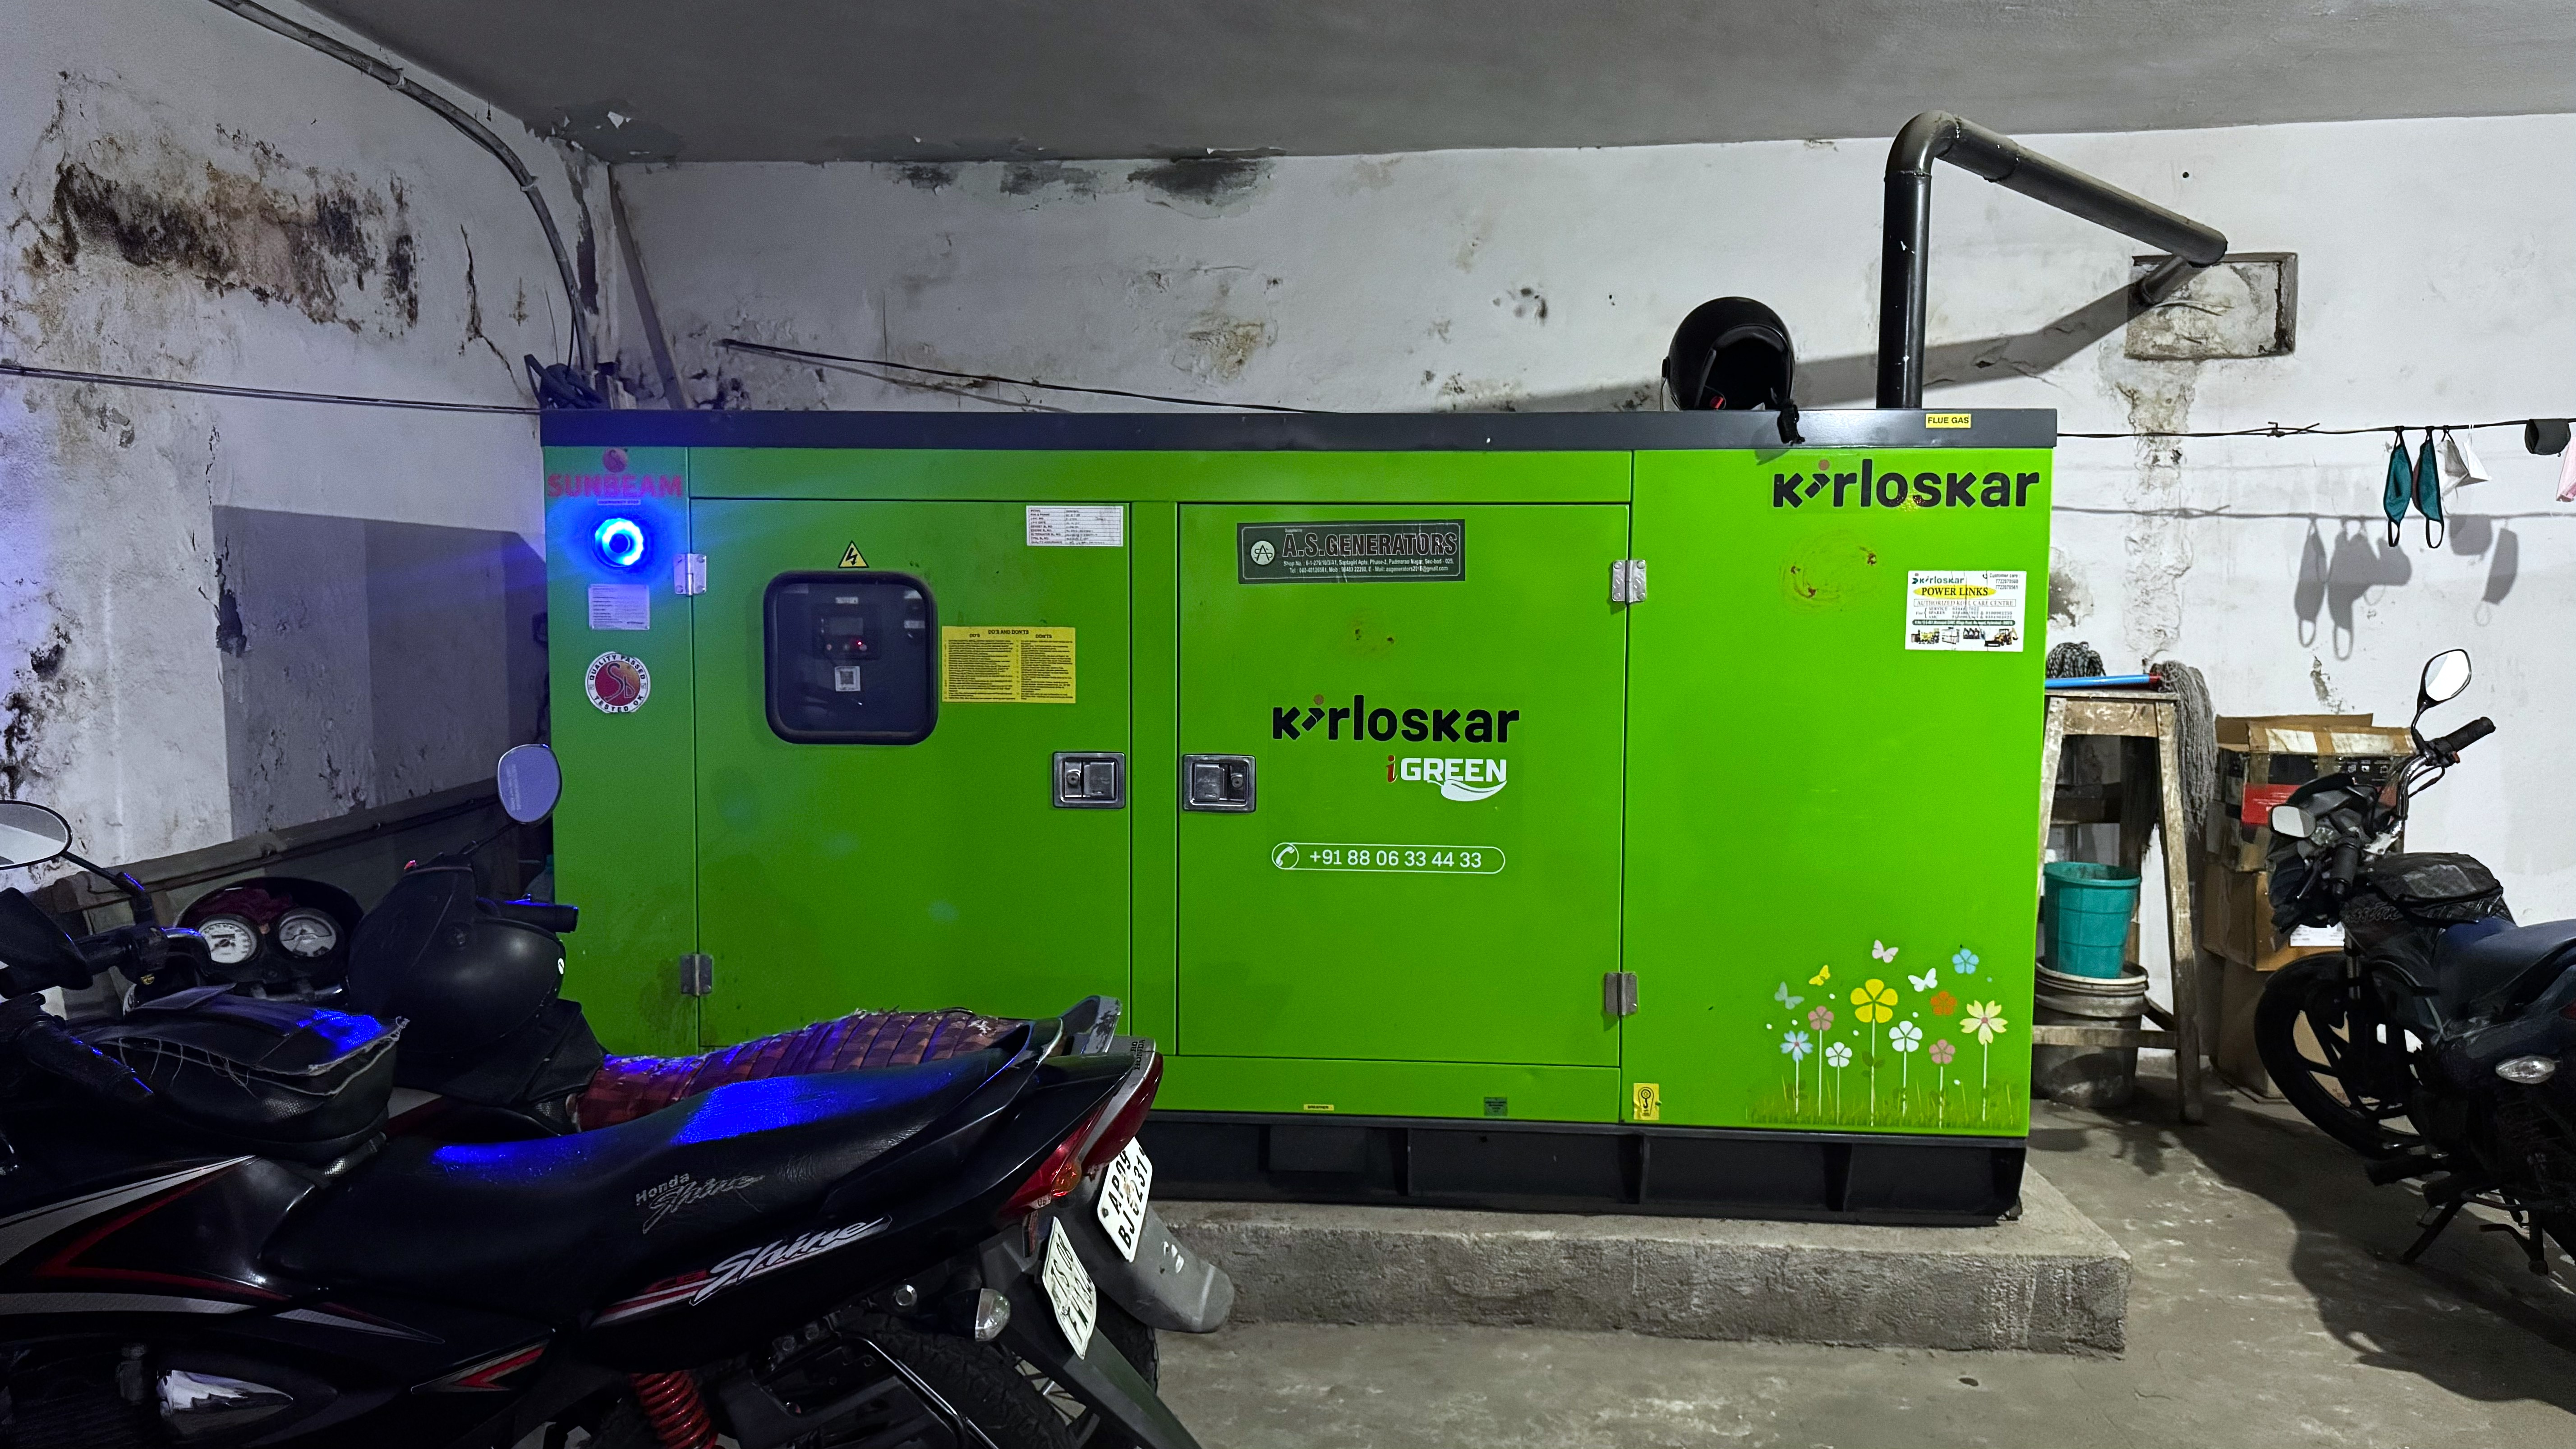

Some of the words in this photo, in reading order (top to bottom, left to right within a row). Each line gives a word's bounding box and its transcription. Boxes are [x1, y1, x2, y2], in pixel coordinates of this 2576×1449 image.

[547, 474, 683, 498] SUNBEAM
[1922, 587, 1956, 596] POWER
[1959, 587, 1988, 596] LINKS
[589, 654, 616, 681] QUALITY
[621, 655, 646, 680] PASSED
[594, 695, 629, 713] TESTED
[633, 695, 644, 706] OK
[1310, 849, 1342, 865] +91
[1348, 850, 1370, 866] 88
[1376, 850, 1398, 866] 06
[1404, 851, 1426, 867] 33
[1432, 851, 1454, 868] 44
[1460, 852, 1482, 869] 33
[635, 1173, 690, 1206] Honda
[643, 1175, 765, 1234] Shine
[688, 1217, 887, 1306] Shine
